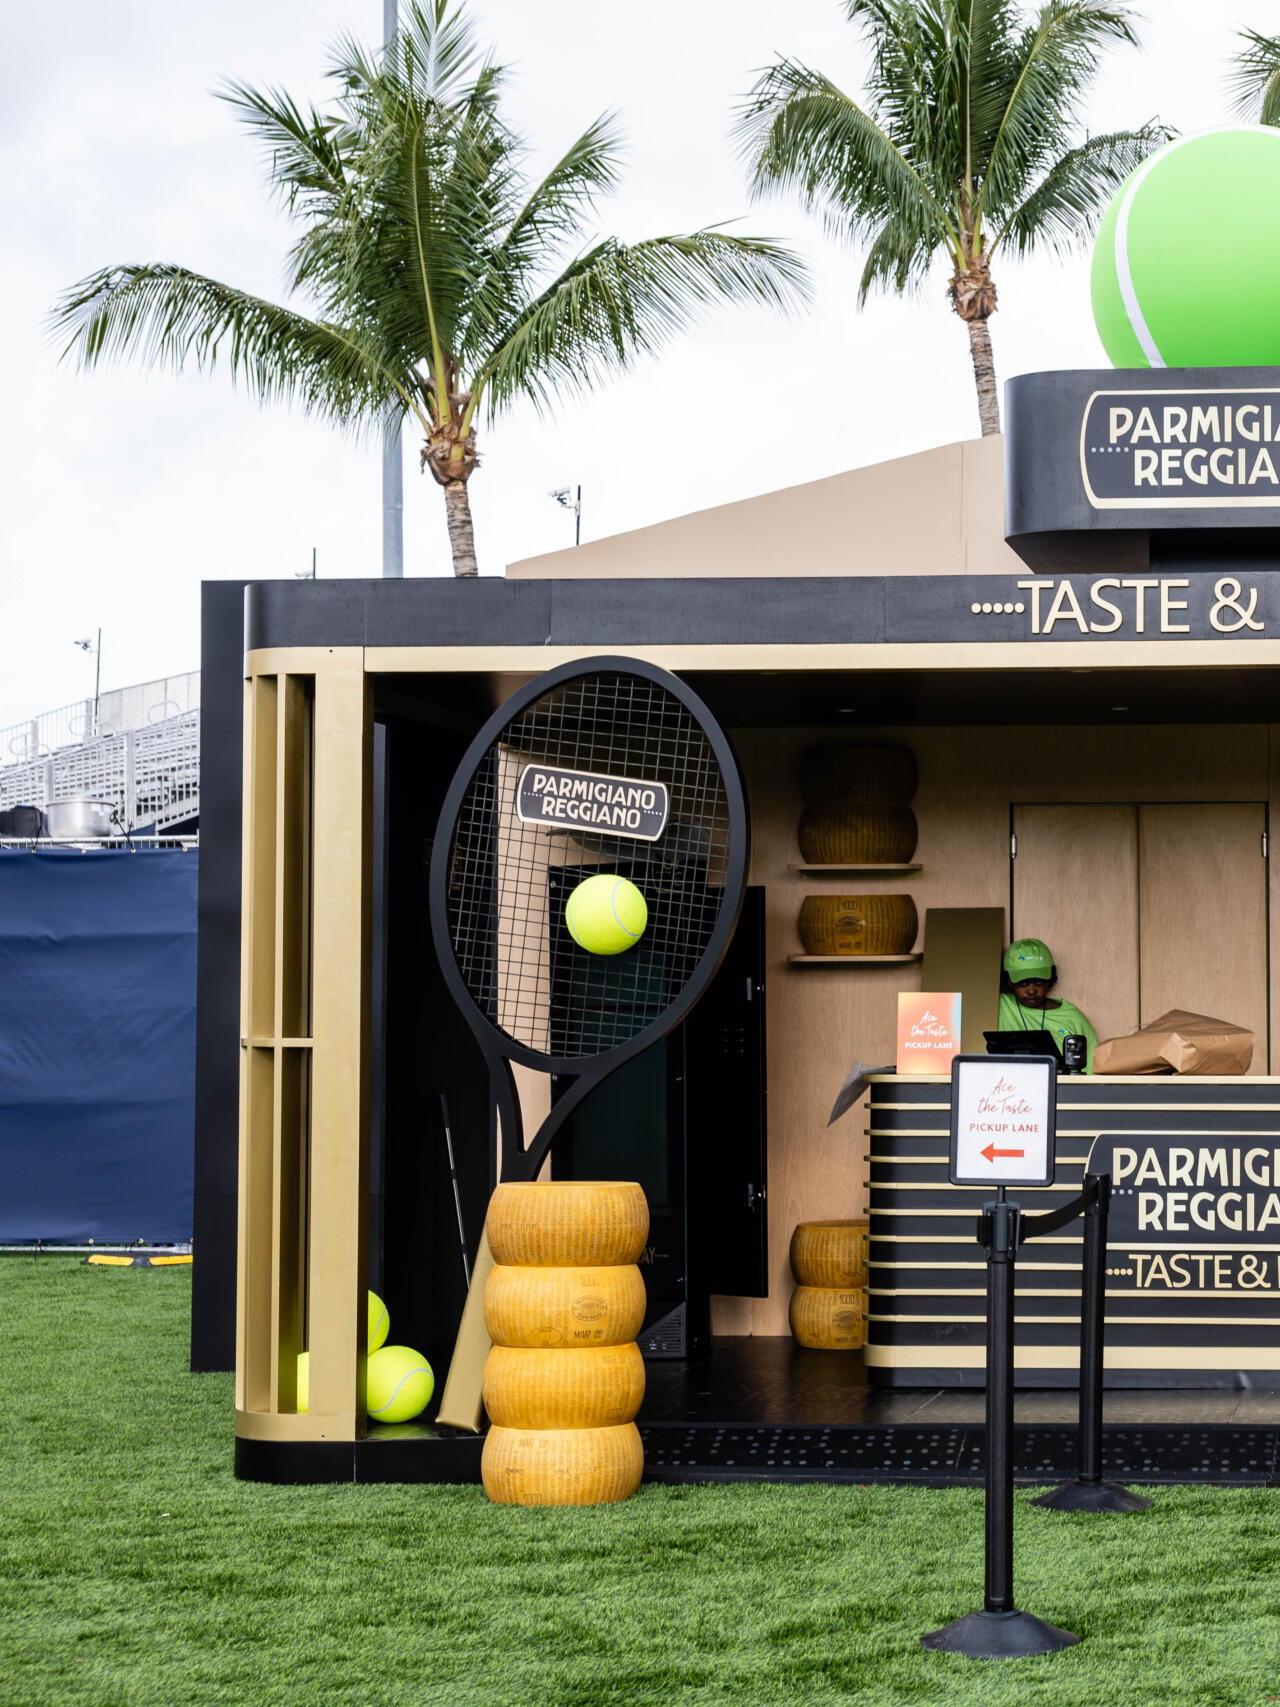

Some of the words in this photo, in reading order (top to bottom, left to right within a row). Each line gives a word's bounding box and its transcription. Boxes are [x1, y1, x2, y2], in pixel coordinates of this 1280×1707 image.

[1018, 578, 1190, 634] TASTE
[1209, 577, 1264, 632] &
[533, 773, 656, 811] PARMIGIANO
[541, 796, 641, 829] REGGIANO
[920, 1010, 938, 1024] Ace
[911, 1024, 925, 1037] the
[924, 1022, 949, 1037] Taste
[993, 1077, 1016, 1096] Ace
[977, 1096, 1000, 1115] the
[998, 1096, 1034, 1116] Taste
[969, 1122, 1008, 1134] PICKUP
[1012, 1122, 1040, 1133] LANE
[1129, 1254, 1234, 1289] TASTE
[1237, 1254, 1271, 1289] &
